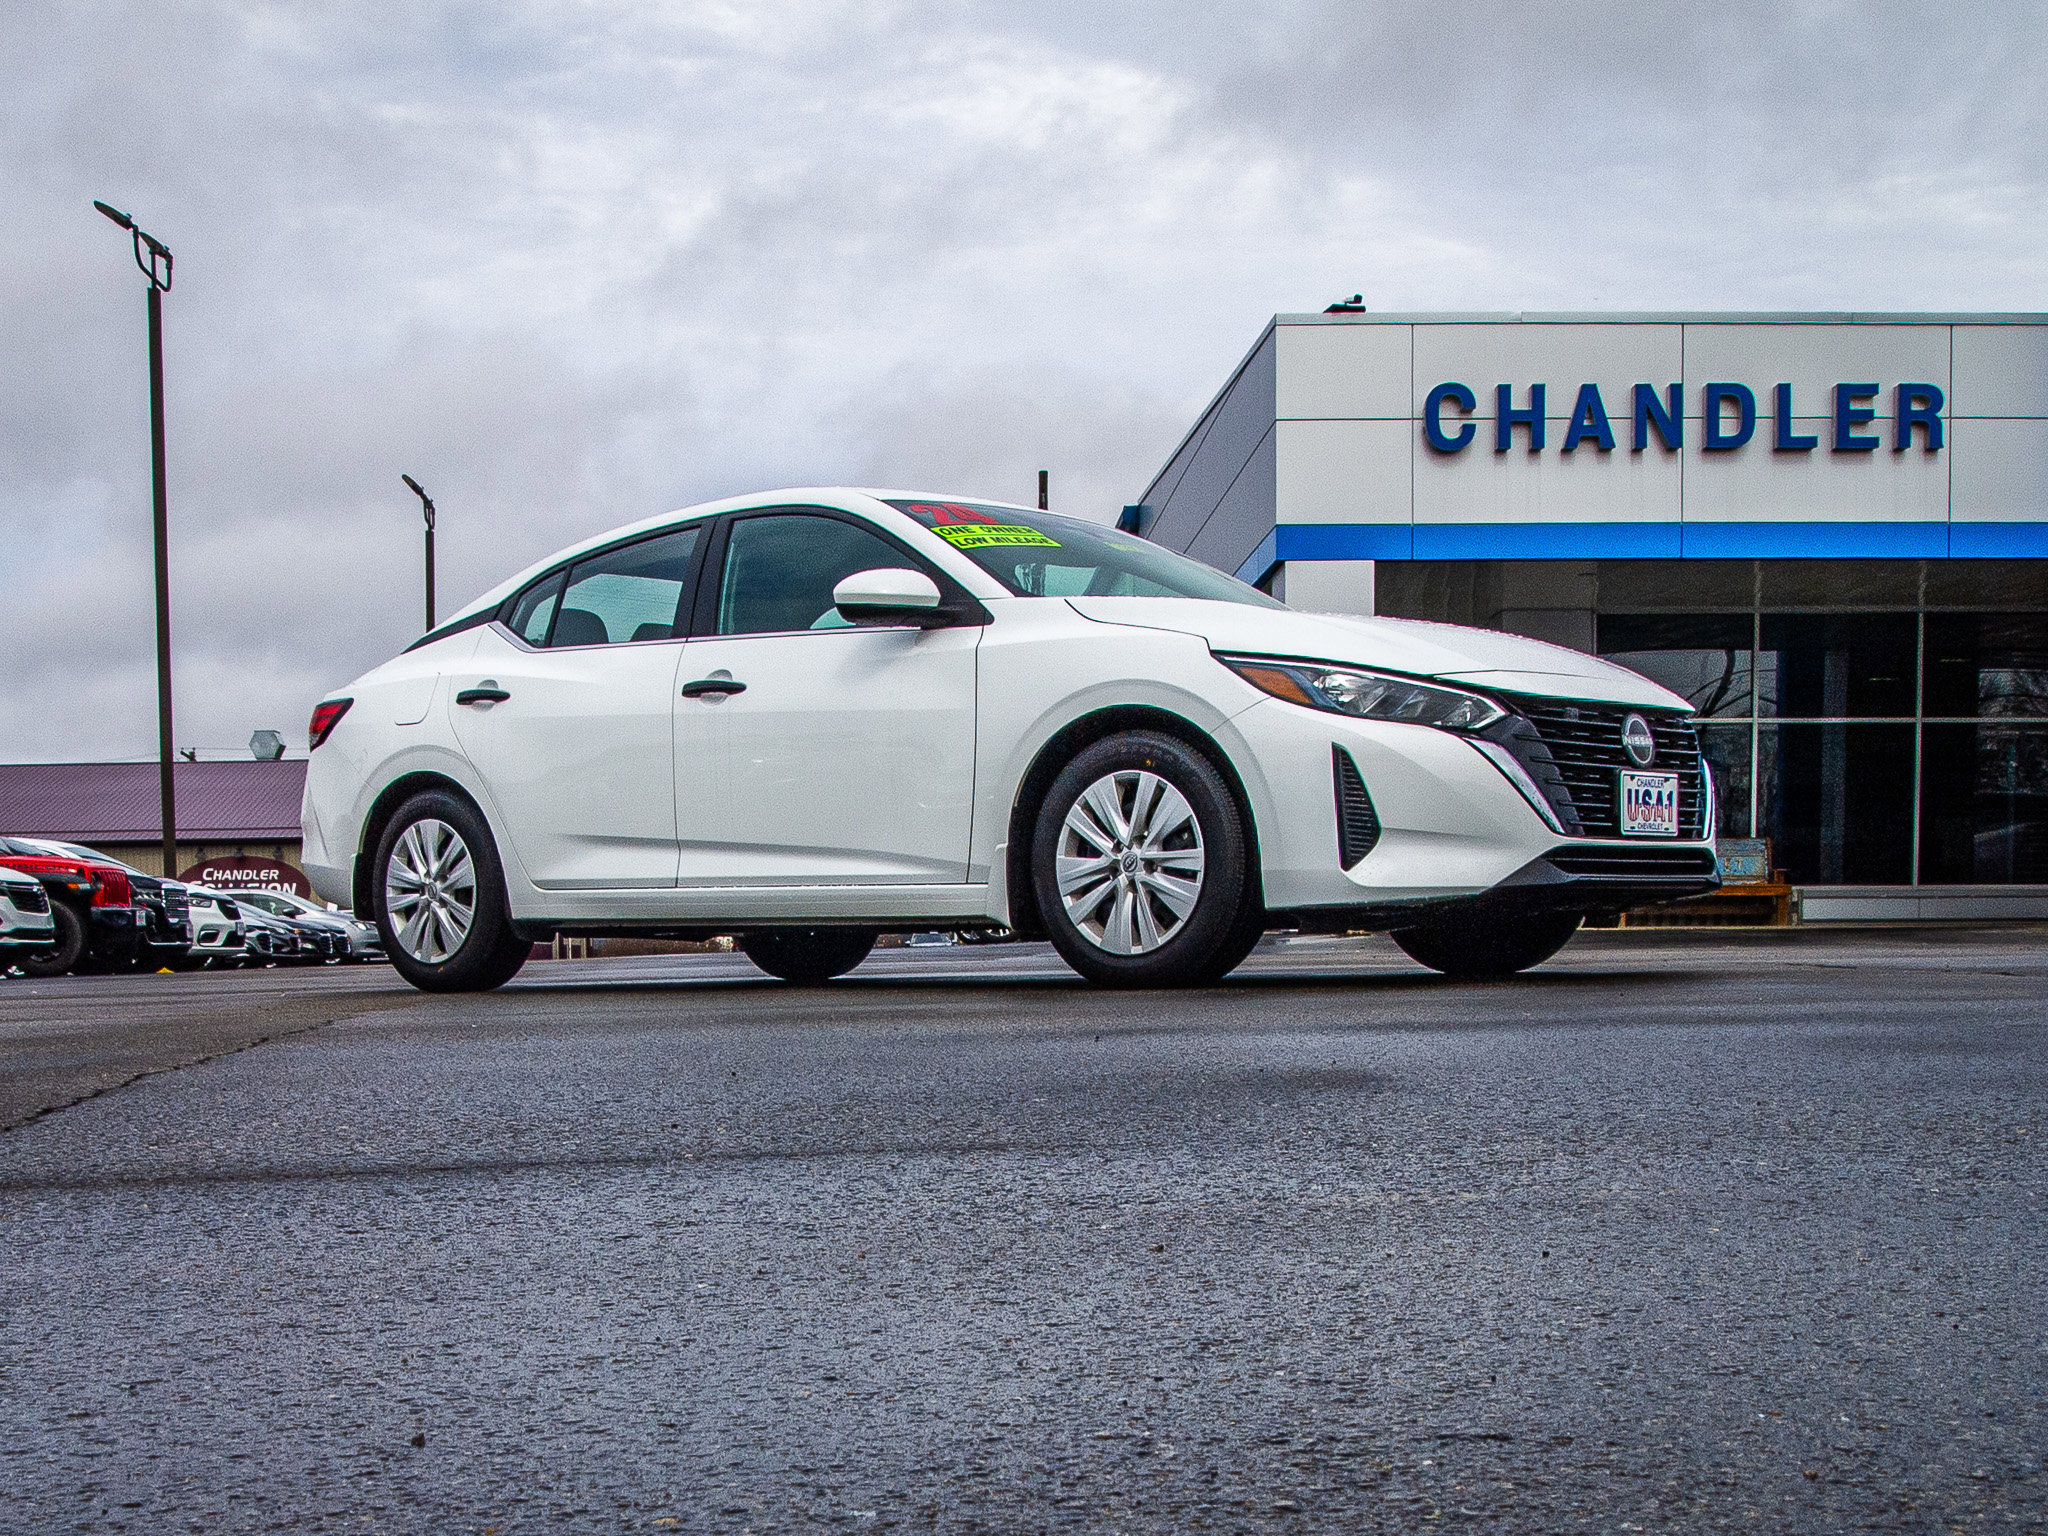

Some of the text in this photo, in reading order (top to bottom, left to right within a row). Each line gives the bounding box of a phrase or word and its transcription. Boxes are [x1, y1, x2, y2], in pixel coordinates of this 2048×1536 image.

[1423, 381, 1946, 452] CHANDLER
[938, 526, 1037, 536] ONE OWNER
[954, 536, 1055, 546] LOW MILEAGE
[1637, 778, 1665, 788] CHANDLER
[1637, 822, 1664, 831] CHEVROLET
[202, 867, 280, 881] CHANDLER
